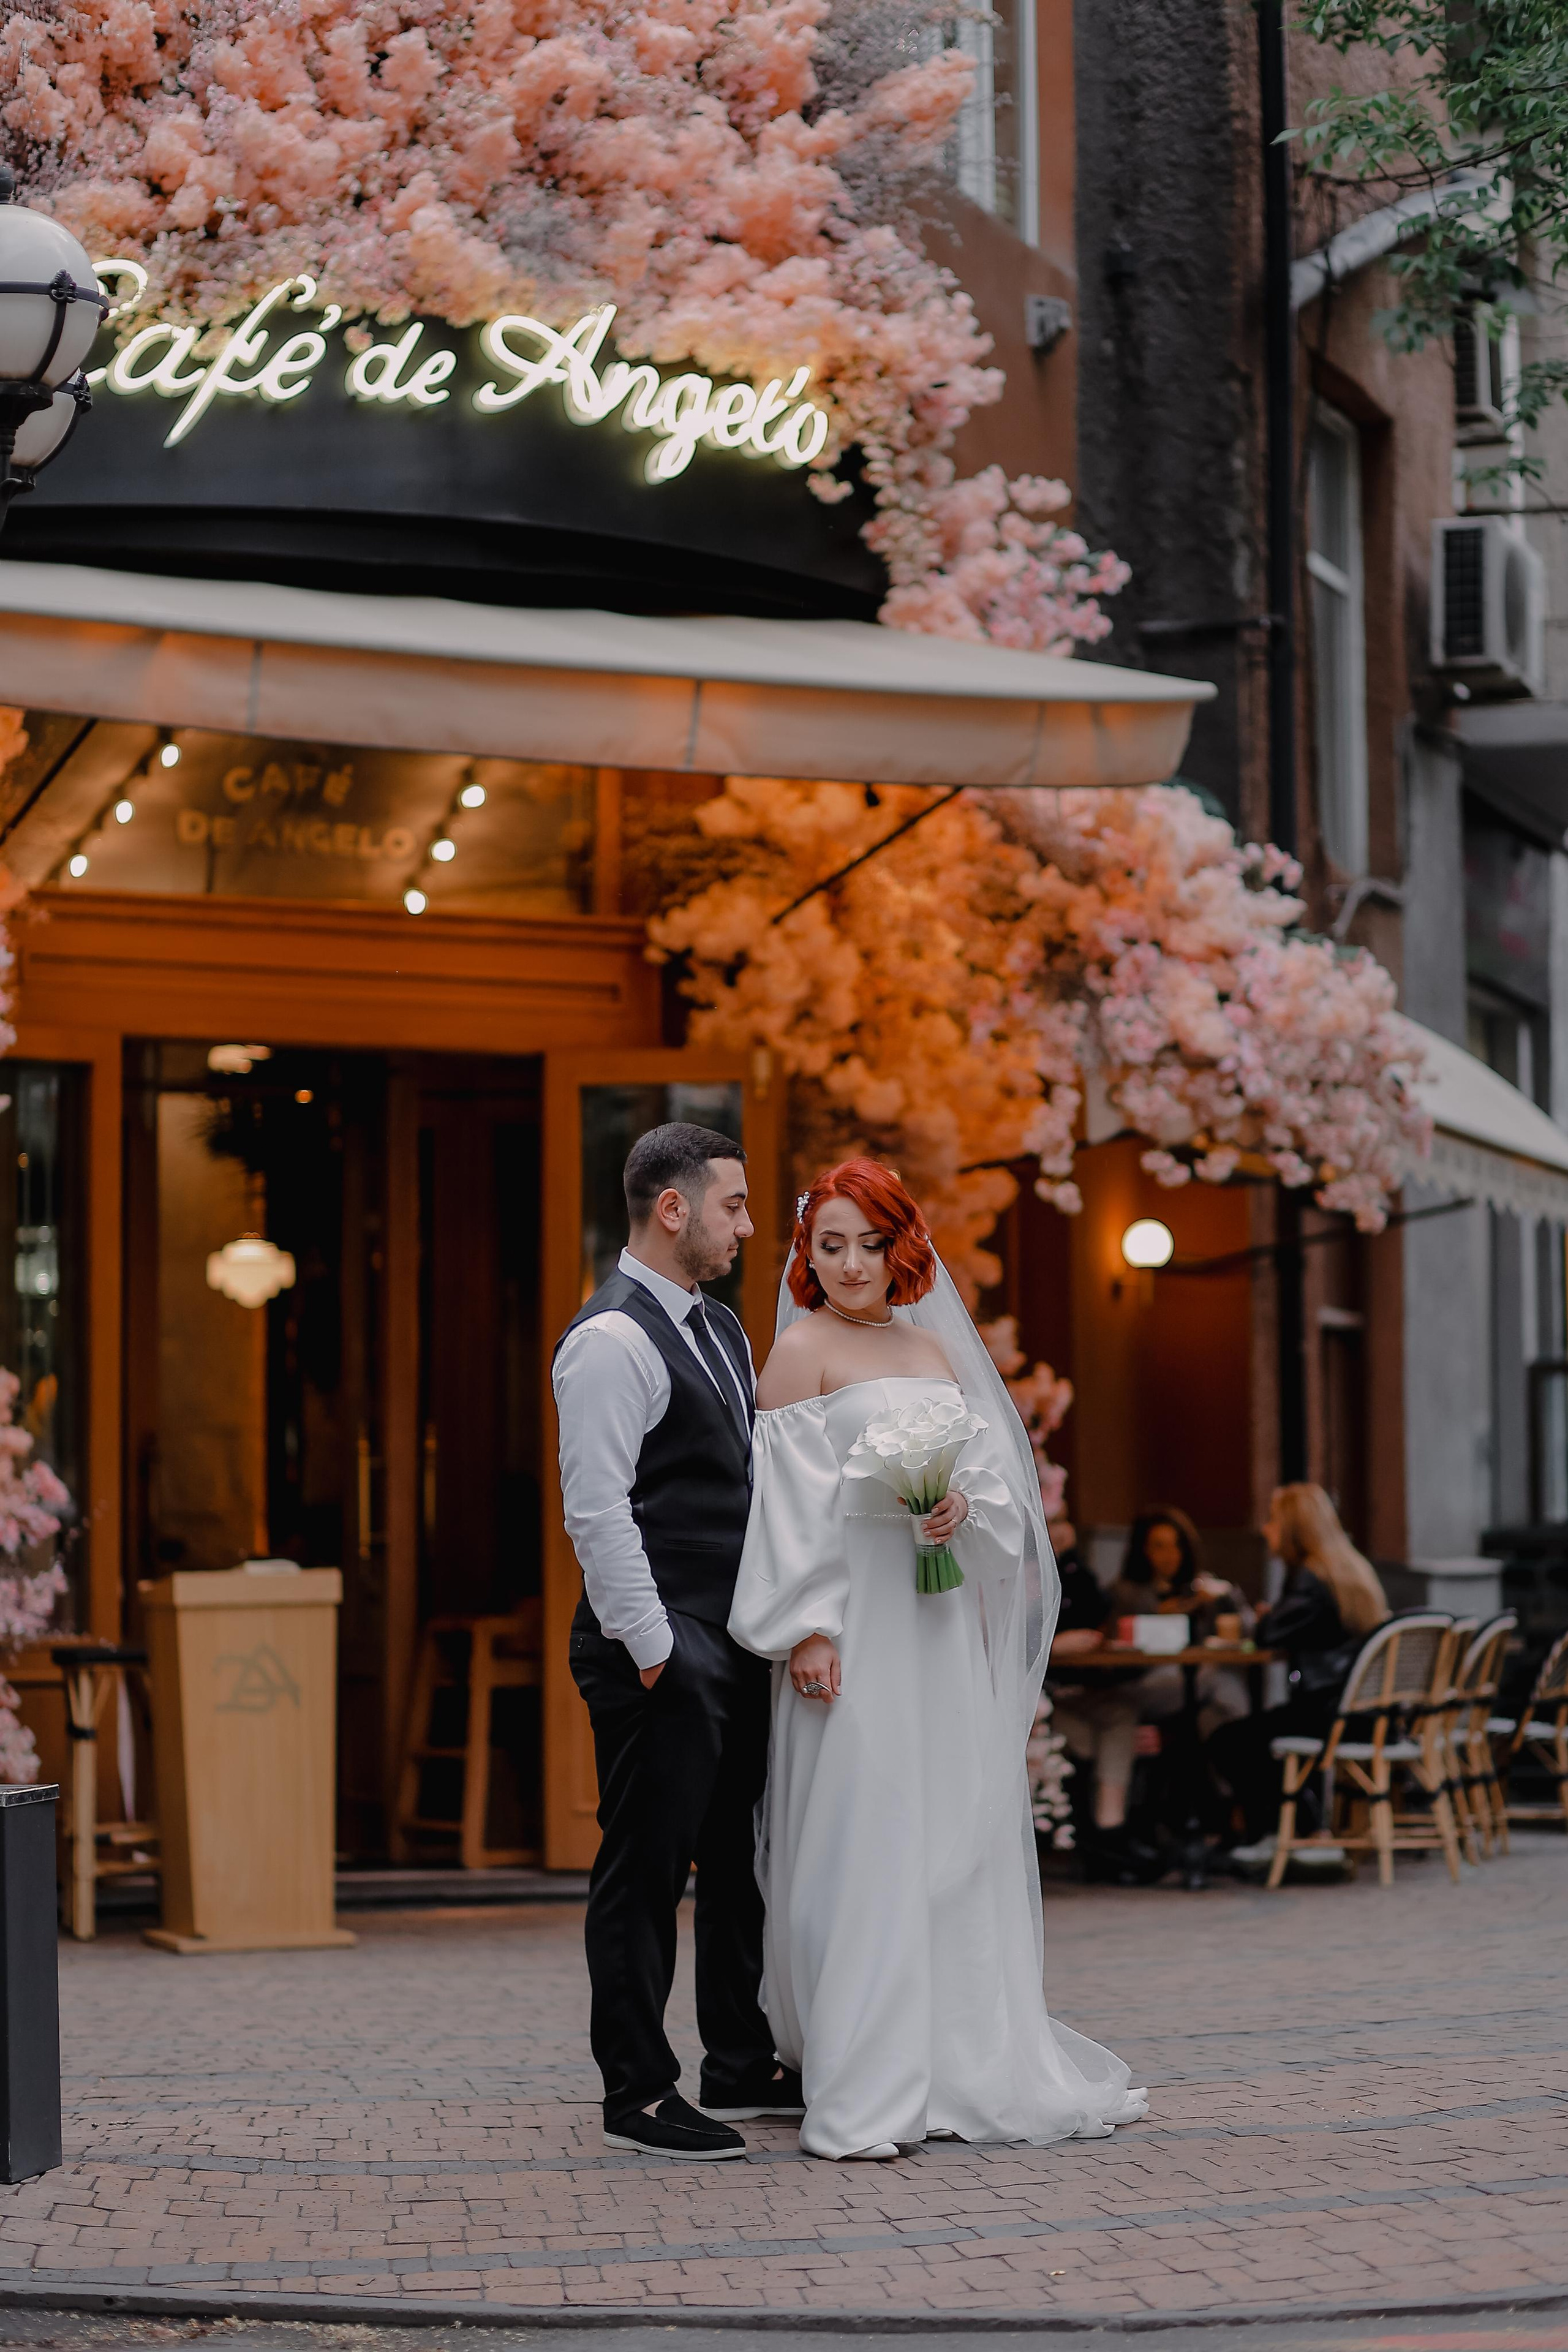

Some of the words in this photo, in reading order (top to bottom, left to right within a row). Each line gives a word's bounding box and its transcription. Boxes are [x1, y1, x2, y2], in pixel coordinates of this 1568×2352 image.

[344, 321, 458, 408] de
[176, 809, 239, 846] DE
[247, 816, 418, 861] ANGELO
